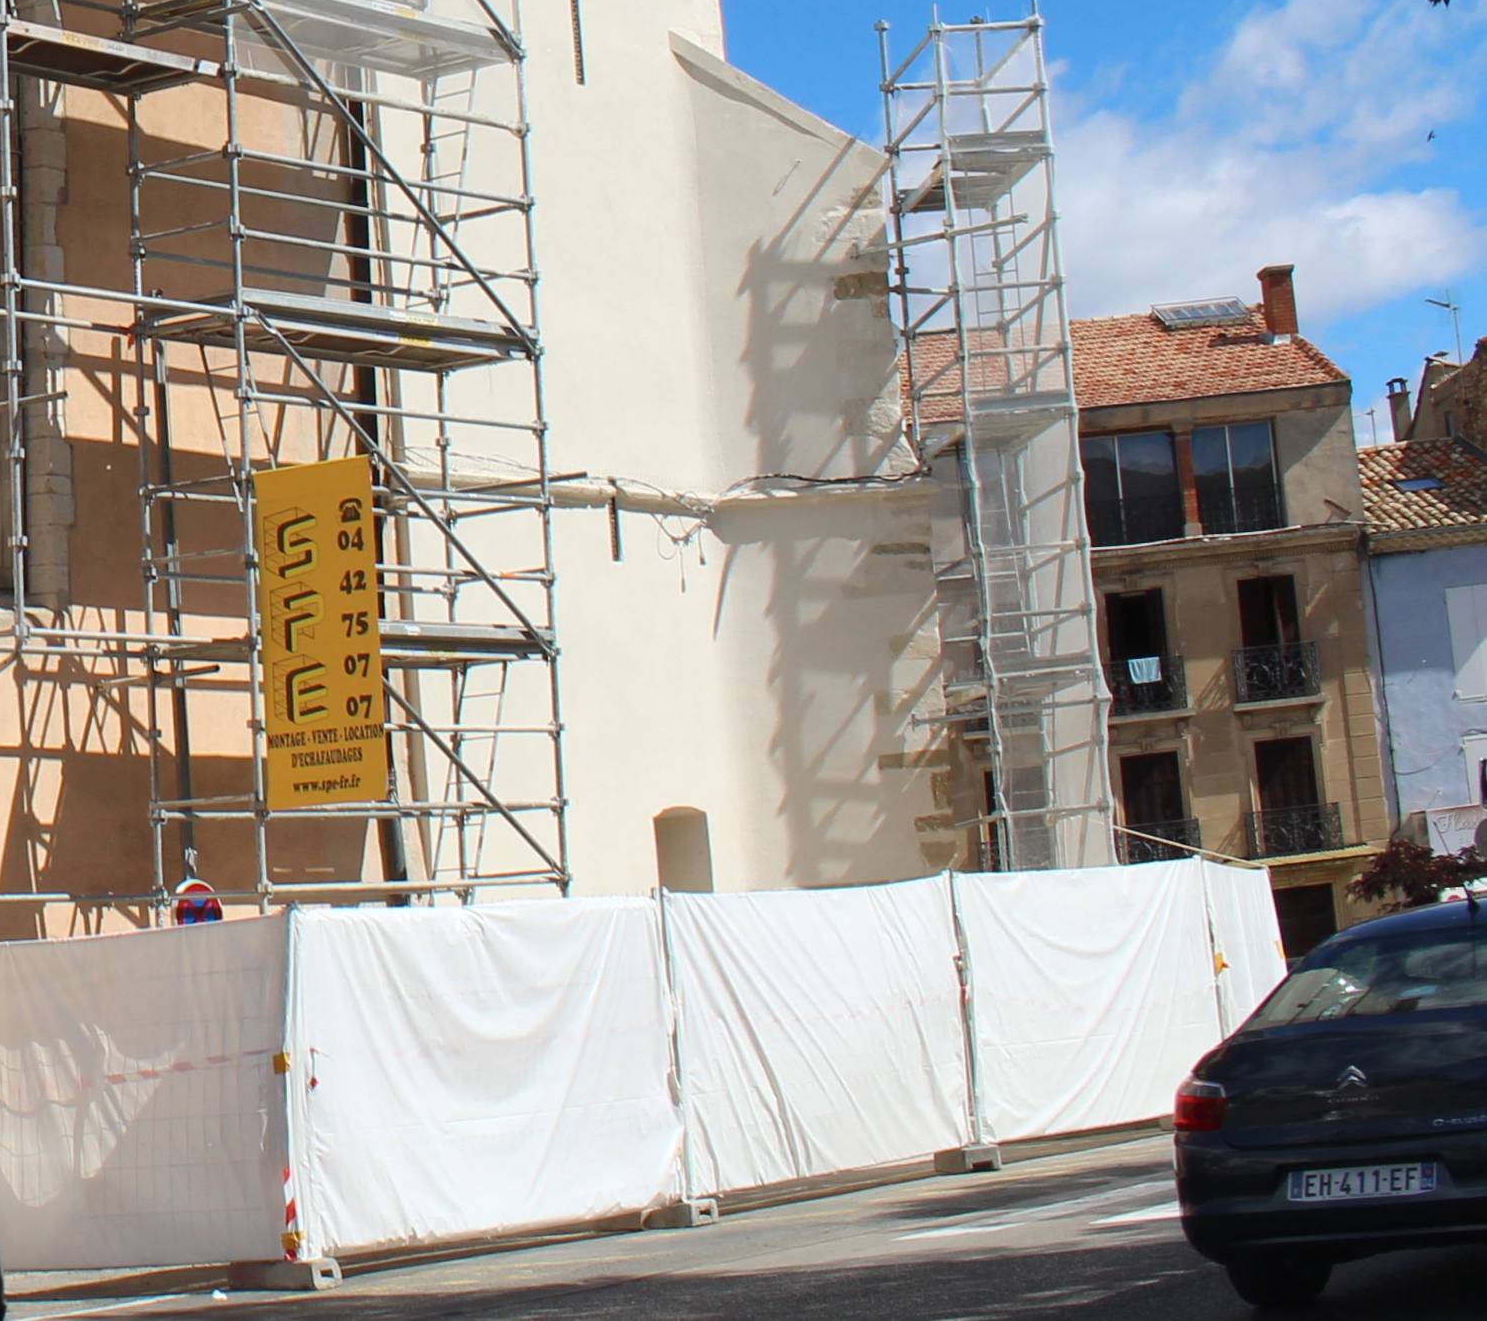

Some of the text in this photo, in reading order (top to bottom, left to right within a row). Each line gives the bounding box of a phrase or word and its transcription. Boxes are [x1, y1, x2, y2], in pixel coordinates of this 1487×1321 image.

[337, 527, 365, 552] 04
[339, 570, 367, 593] 42
[341, 611, 370, 637] 75
[343, 653, 371, 677] 07
[345, 695, 373, 719] 07
[312, 728, 338, 744] VENTE
[344, 723, 384, 741] LOCATION
[1304, 1167, 1418, 1197] EH-411-EF
